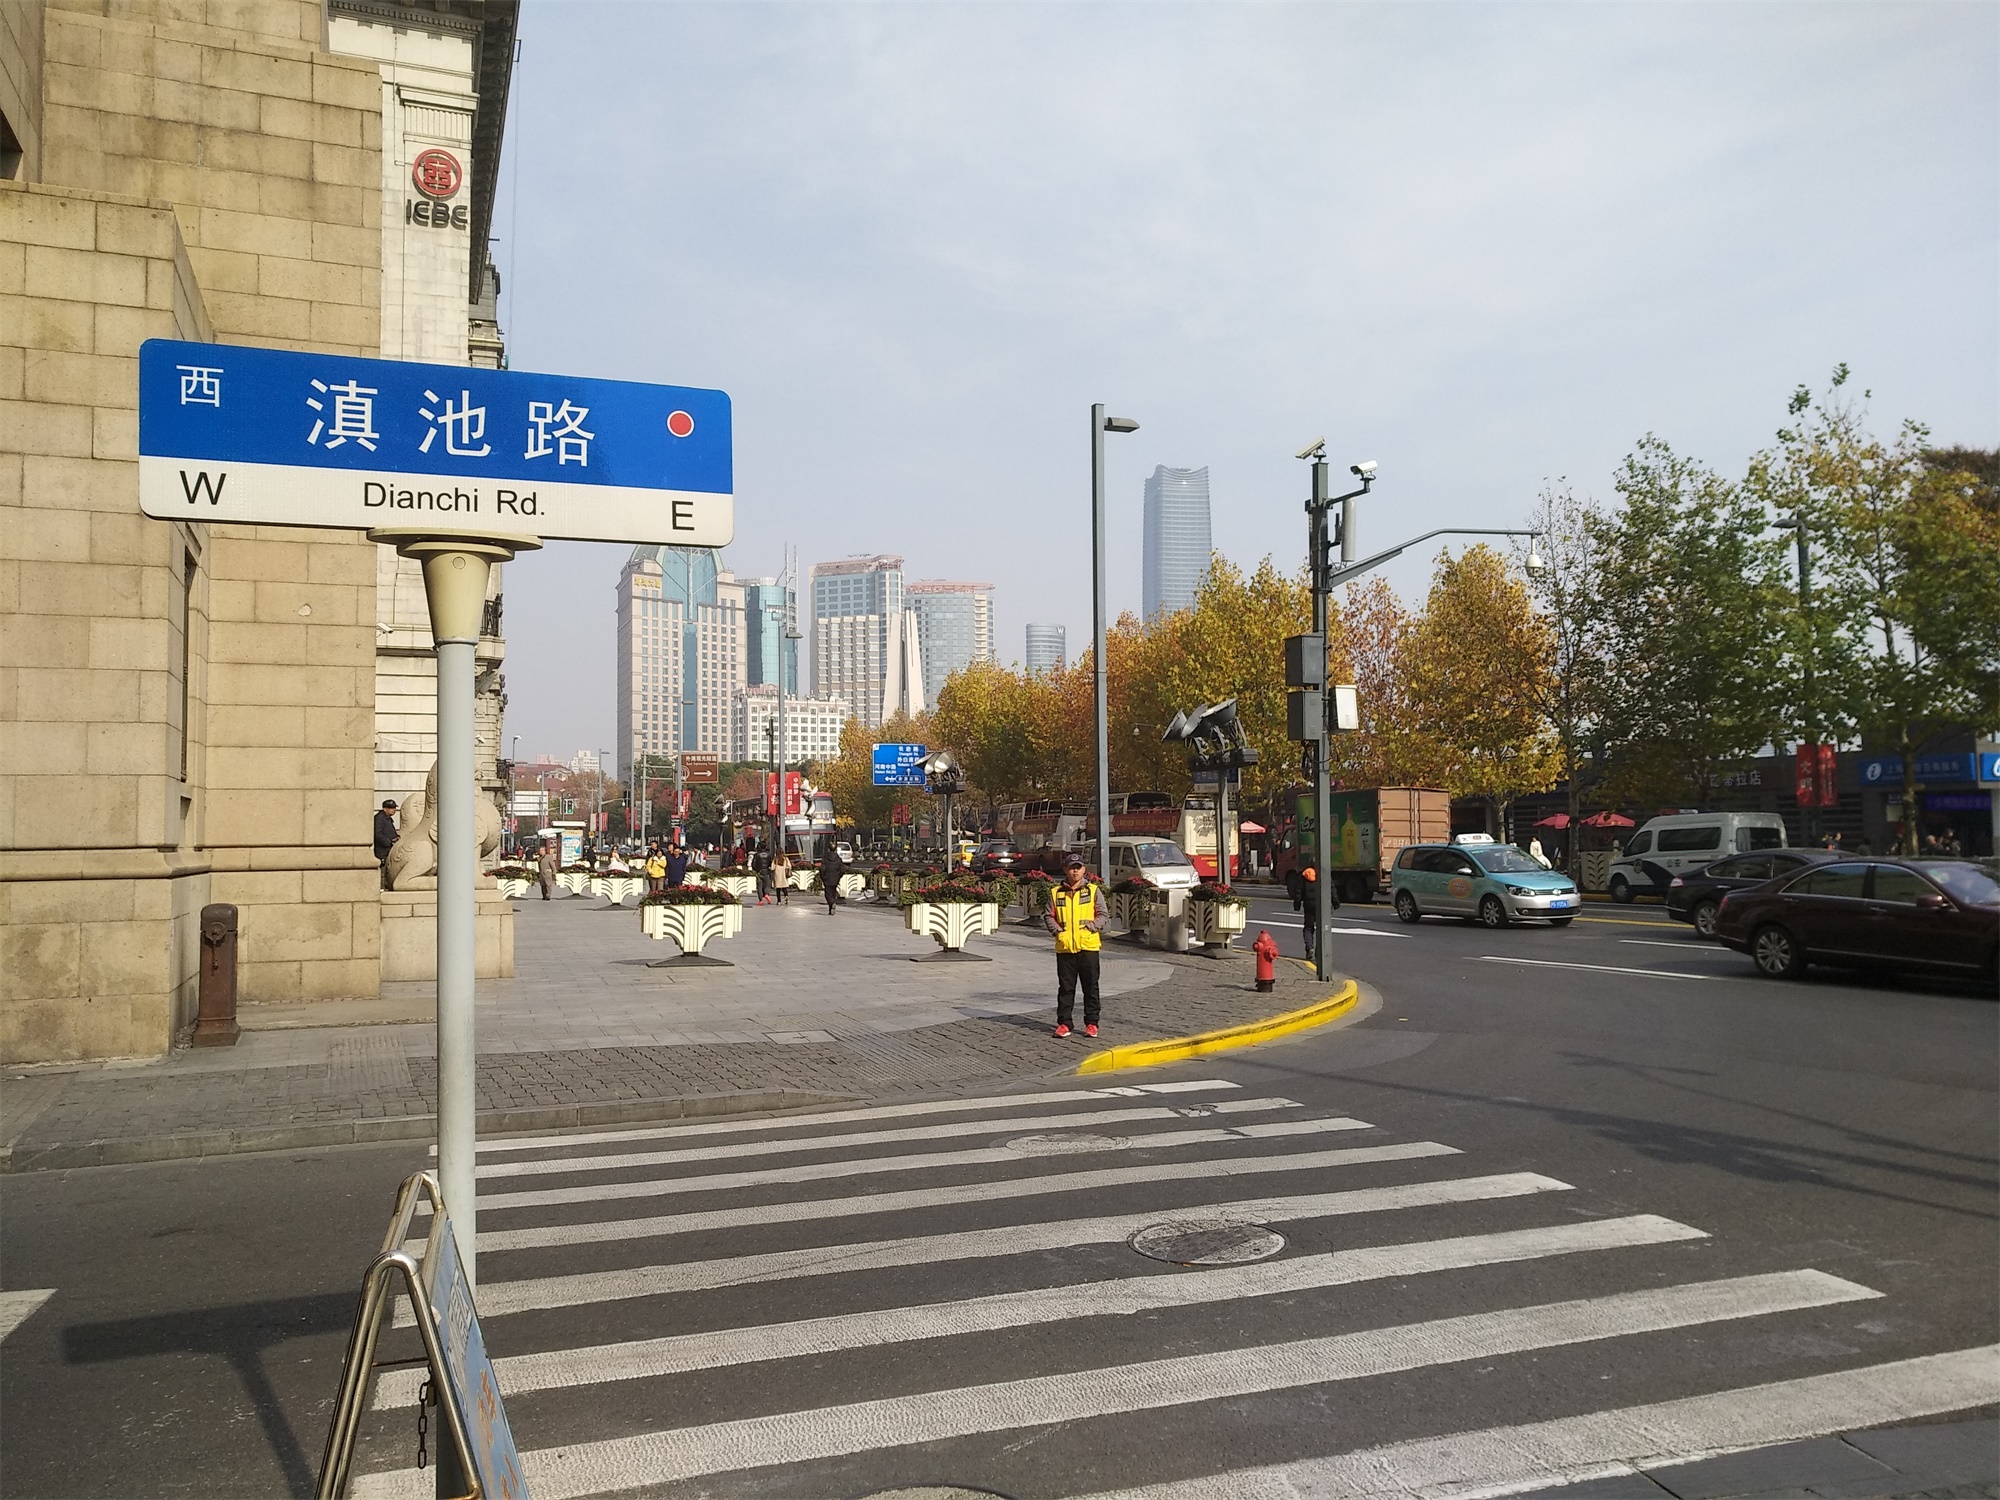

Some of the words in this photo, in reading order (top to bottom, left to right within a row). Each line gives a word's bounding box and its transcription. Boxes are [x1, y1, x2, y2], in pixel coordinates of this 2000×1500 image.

[176, 364, 224, 408] 西
[306, 378, 595, 468] 滇池路
[179, 470, 227, 506] W
[363, 481, 480, 514] Dianchi
[496, 489, 546, 517] Rd.
[671, 500, 695, 531] E
[1667, 859, 1681, 868] 公安
